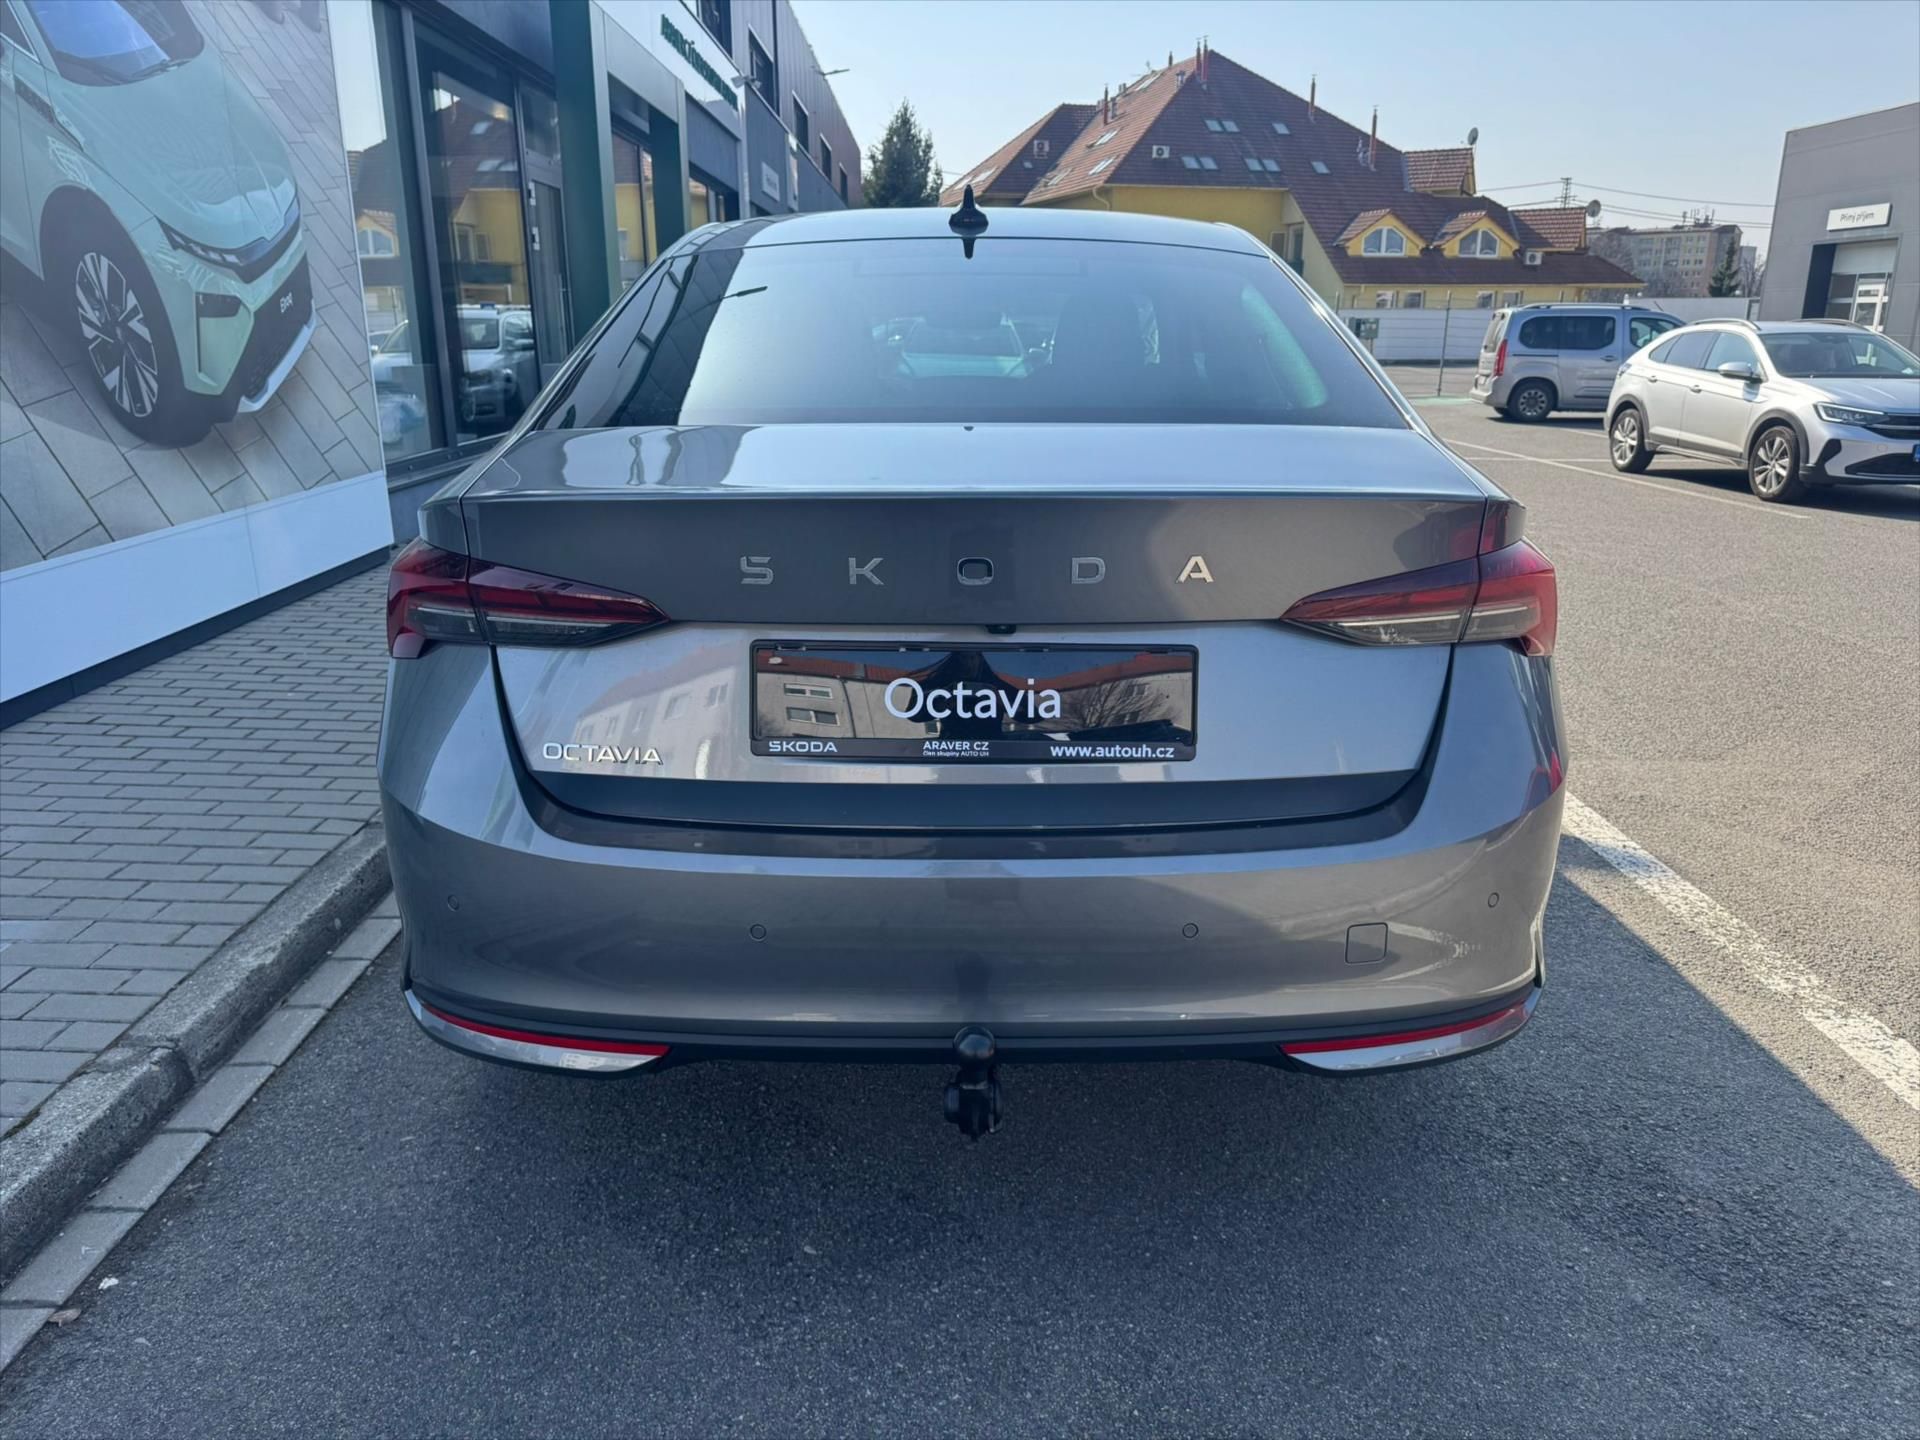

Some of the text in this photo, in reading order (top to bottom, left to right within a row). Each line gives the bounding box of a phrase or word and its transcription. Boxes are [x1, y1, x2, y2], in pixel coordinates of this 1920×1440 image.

[884, 677, 1061, 719] Octavia
[543, 743, 663, 765] OCTAVIA
[923, 741, 989, 751] ARAVER CZ
[1050, 744, 1175, 758] www.autouh.cz
